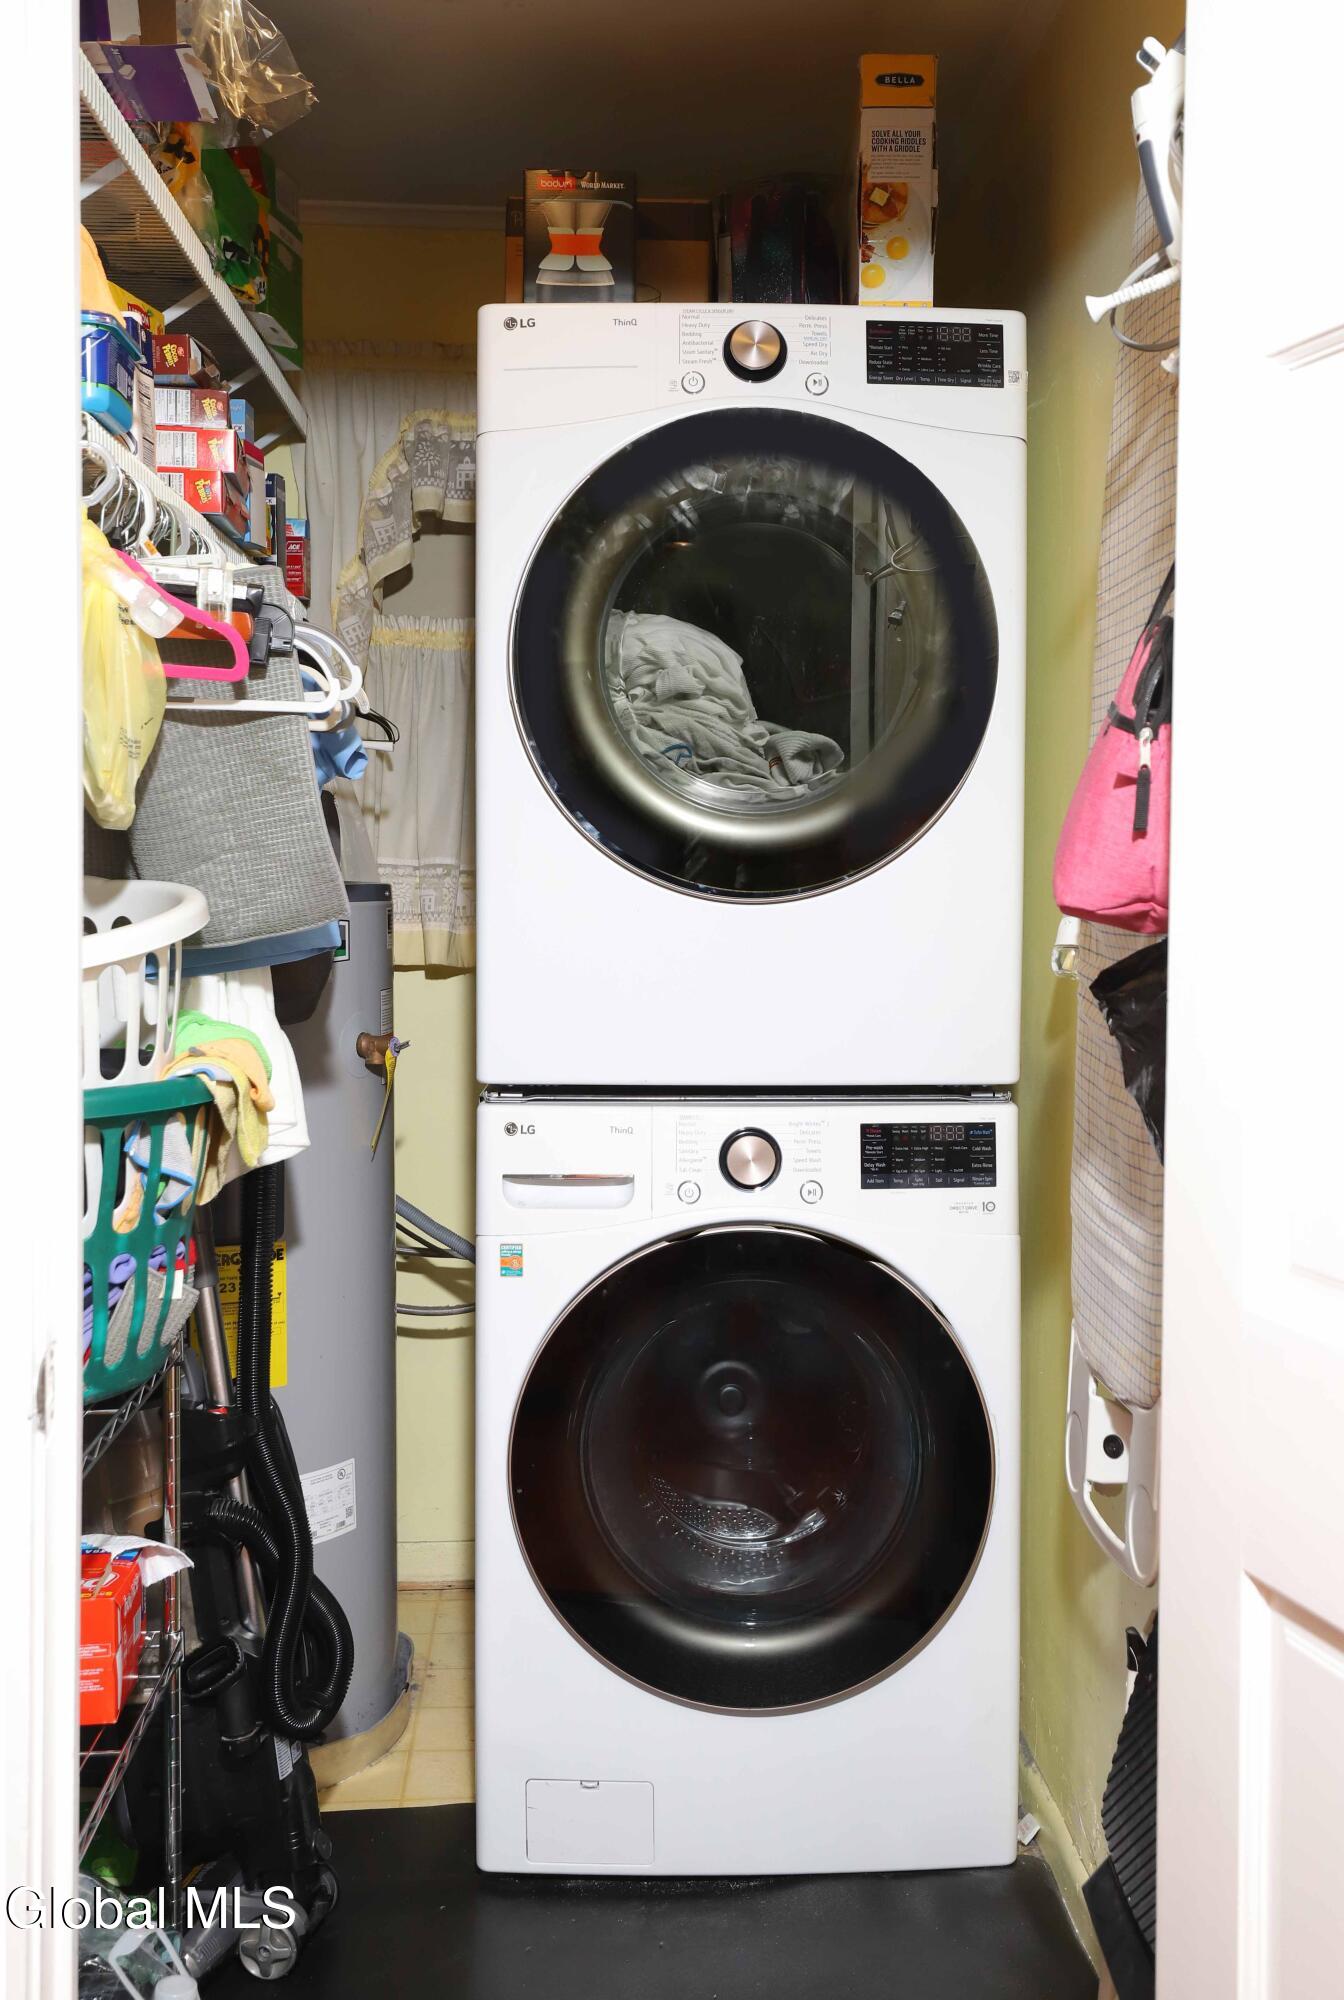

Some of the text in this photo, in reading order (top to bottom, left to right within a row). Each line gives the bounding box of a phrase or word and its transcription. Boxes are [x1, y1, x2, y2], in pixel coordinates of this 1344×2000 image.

[884, 76, 916, 84] BELLA
[871, 130, 921, 138] SOLVE ALL YOUR
[871, 137, 927, 145] COOKING RIDDLES
[871, 145, 921, 153] WITH A GRIDDLE
[540, 178, 573, 188] bodum
[519, 317, 536, 328] LG
[612, 317, 638, 327] ThinQ
[520, 1124, 536, 1135] LG
[609, 1125, 634, 1135] ThinQ
[982, 1201, 996, 1213] 10
